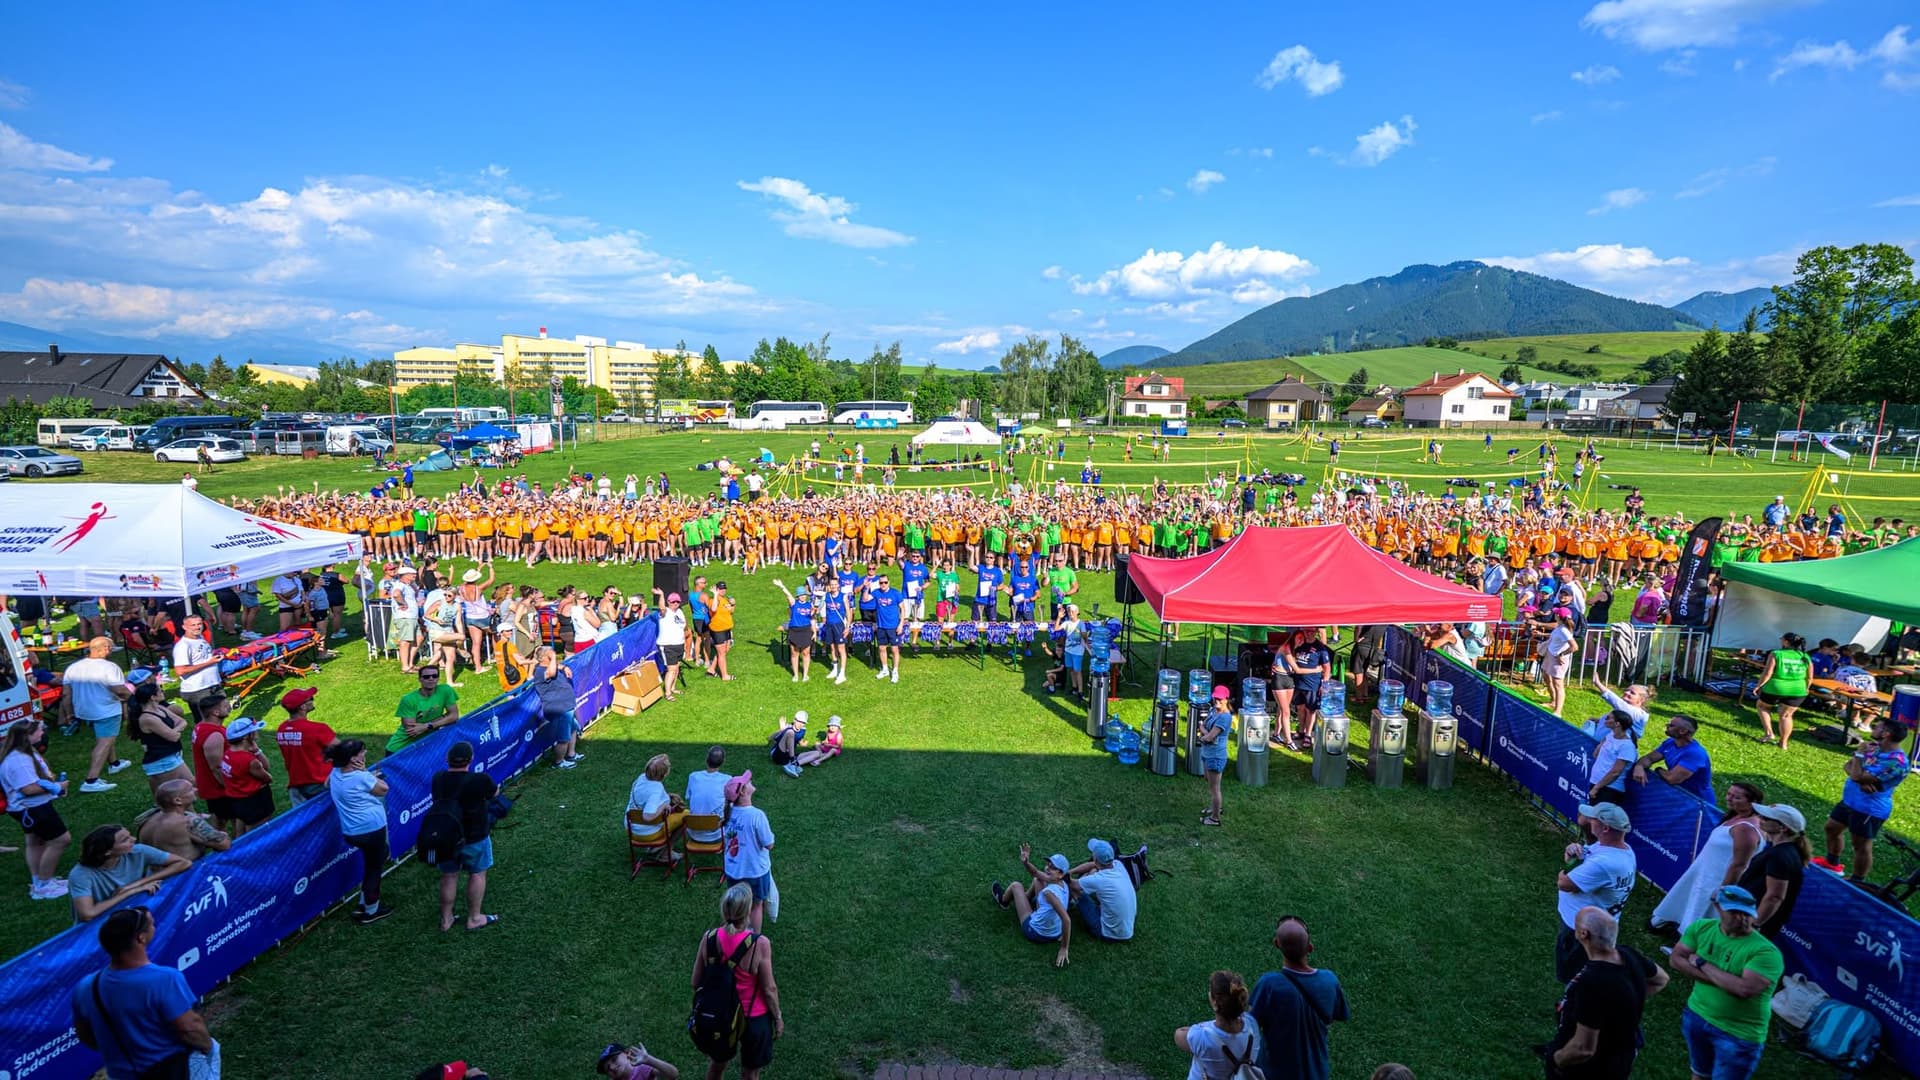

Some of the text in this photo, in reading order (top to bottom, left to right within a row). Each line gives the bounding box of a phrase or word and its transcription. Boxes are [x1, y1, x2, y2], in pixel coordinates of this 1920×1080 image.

[7, 706, 24, 720] 625
[1566, 750, 1582, 766] SVF
[184, 891, 213, 922] SVF
[205, 895, 277, 946] Slovak Volleyball
[207, 921, 251, 956] Federation
[1780, 925, 1813, 951] balová
[1854, 931, 1889, 957] SVF
[1865, 983, 1903, 1012] Slovak
[1864, 993, 1920, 1037] Federation
[14, 1027, 77, 1070] Slovensk
